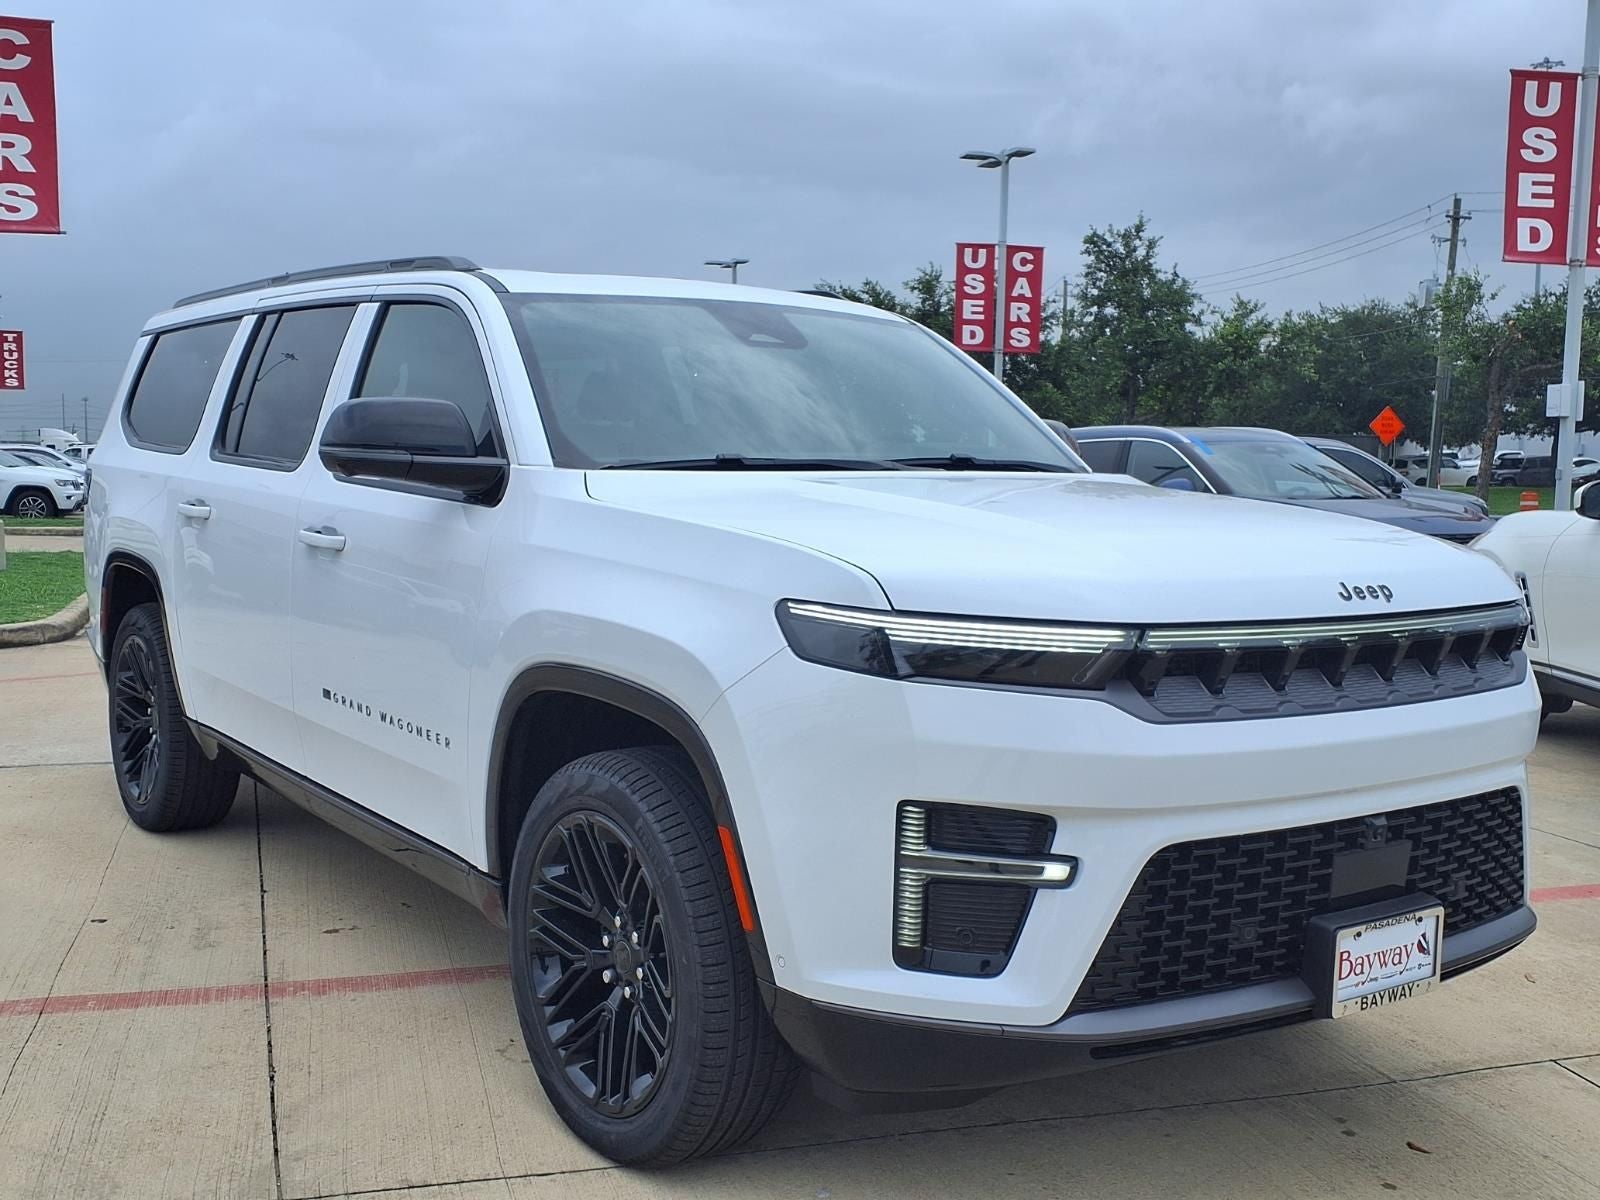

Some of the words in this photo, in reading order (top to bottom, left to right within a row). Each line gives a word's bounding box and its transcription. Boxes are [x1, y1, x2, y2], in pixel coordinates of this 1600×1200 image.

[0, 28, 38, 221] CARS
[1516, 80, 1562, 252] USED
[962, 248, 987, 345] USED
[1010, 252, 1034, 347] CARS
[3, 333, 19, 387] TRUCKS
[1338, 581, 1393, 603] Jeep
[333, 692, 372, 717] GRAND
[379, 710, 451, 750] WAGONEER
[1364, 913, 1416, 932] PASADENA
[1338, 942, 1415, 985] Bayway
[1360, 982, 1415, 1011] BAYWAY
